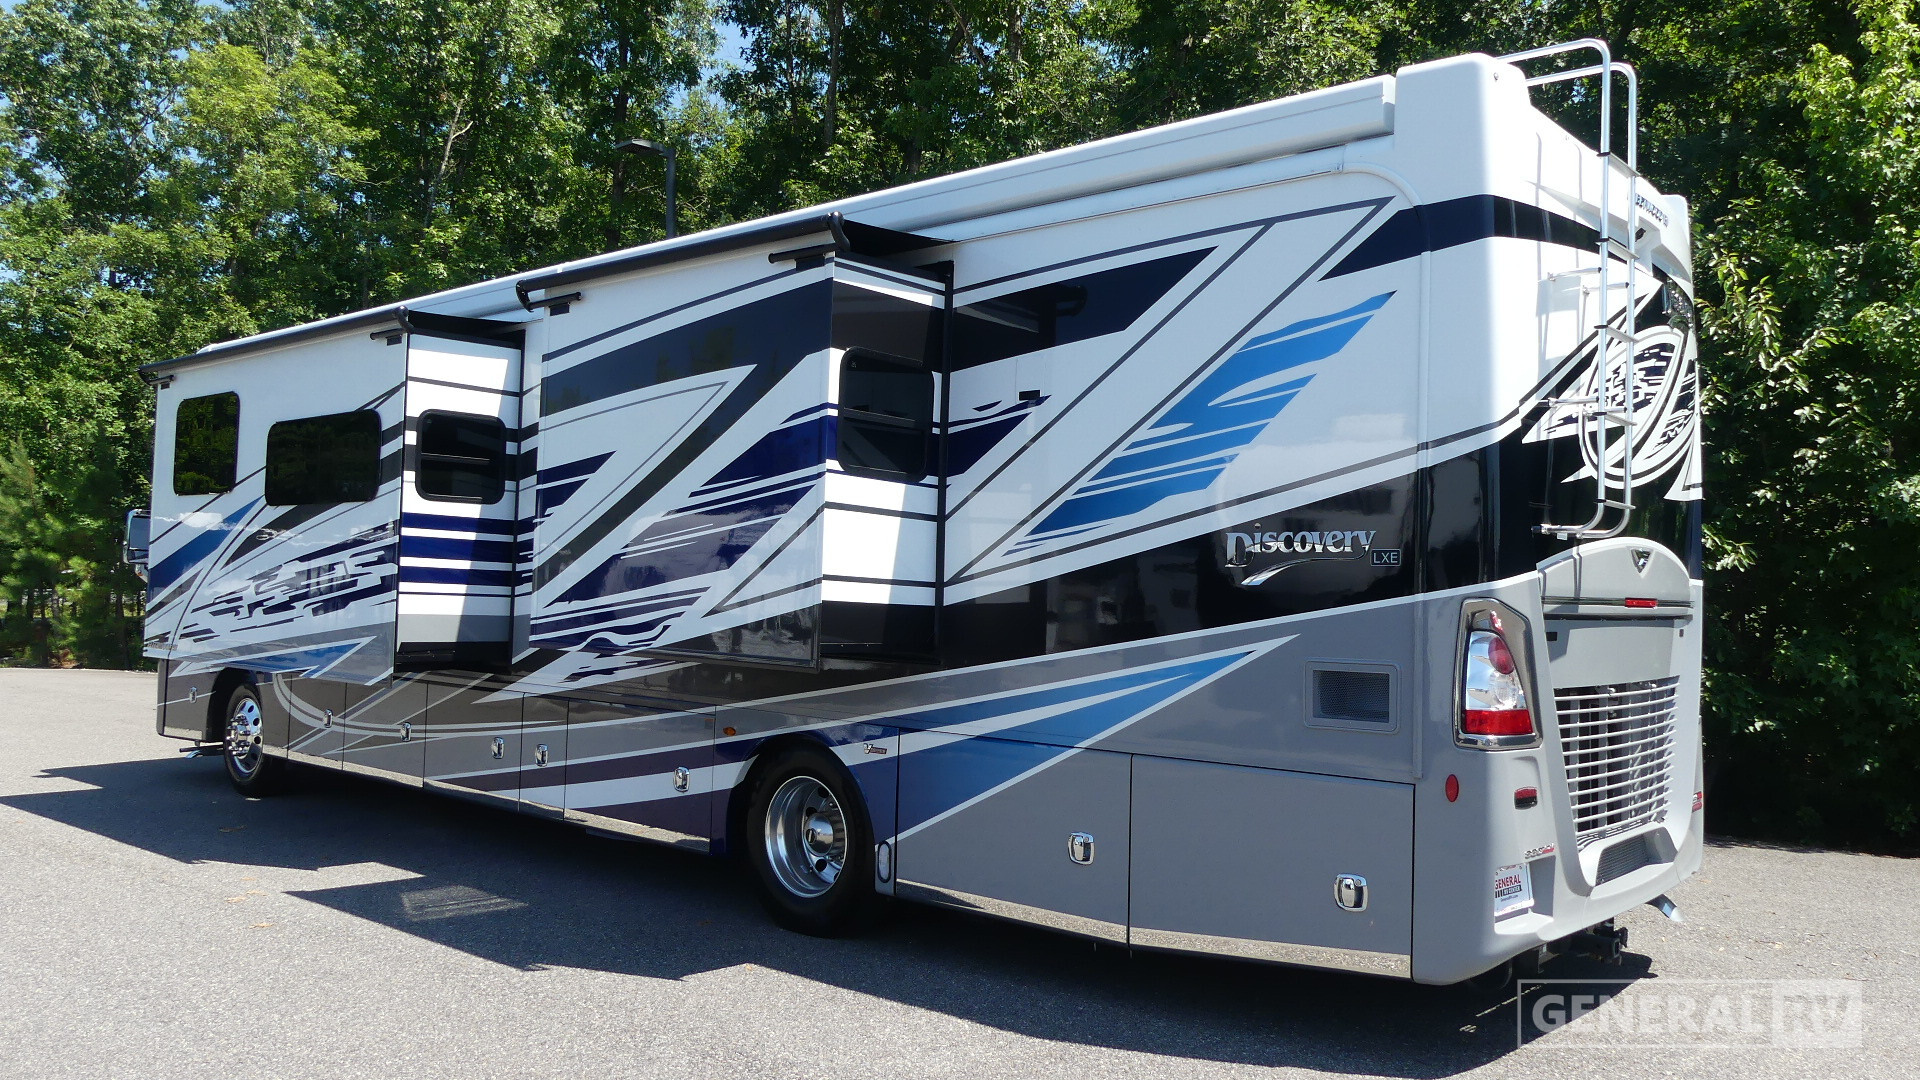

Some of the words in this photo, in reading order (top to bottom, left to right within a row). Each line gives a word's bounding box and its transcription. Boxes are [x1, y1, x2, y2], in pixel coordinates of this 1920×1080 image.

[1225, 523, 1376, 567] Discovery
[1373, 552, 1398, 564] LXE
[1494, 874, 1521, 890] GENERAL
